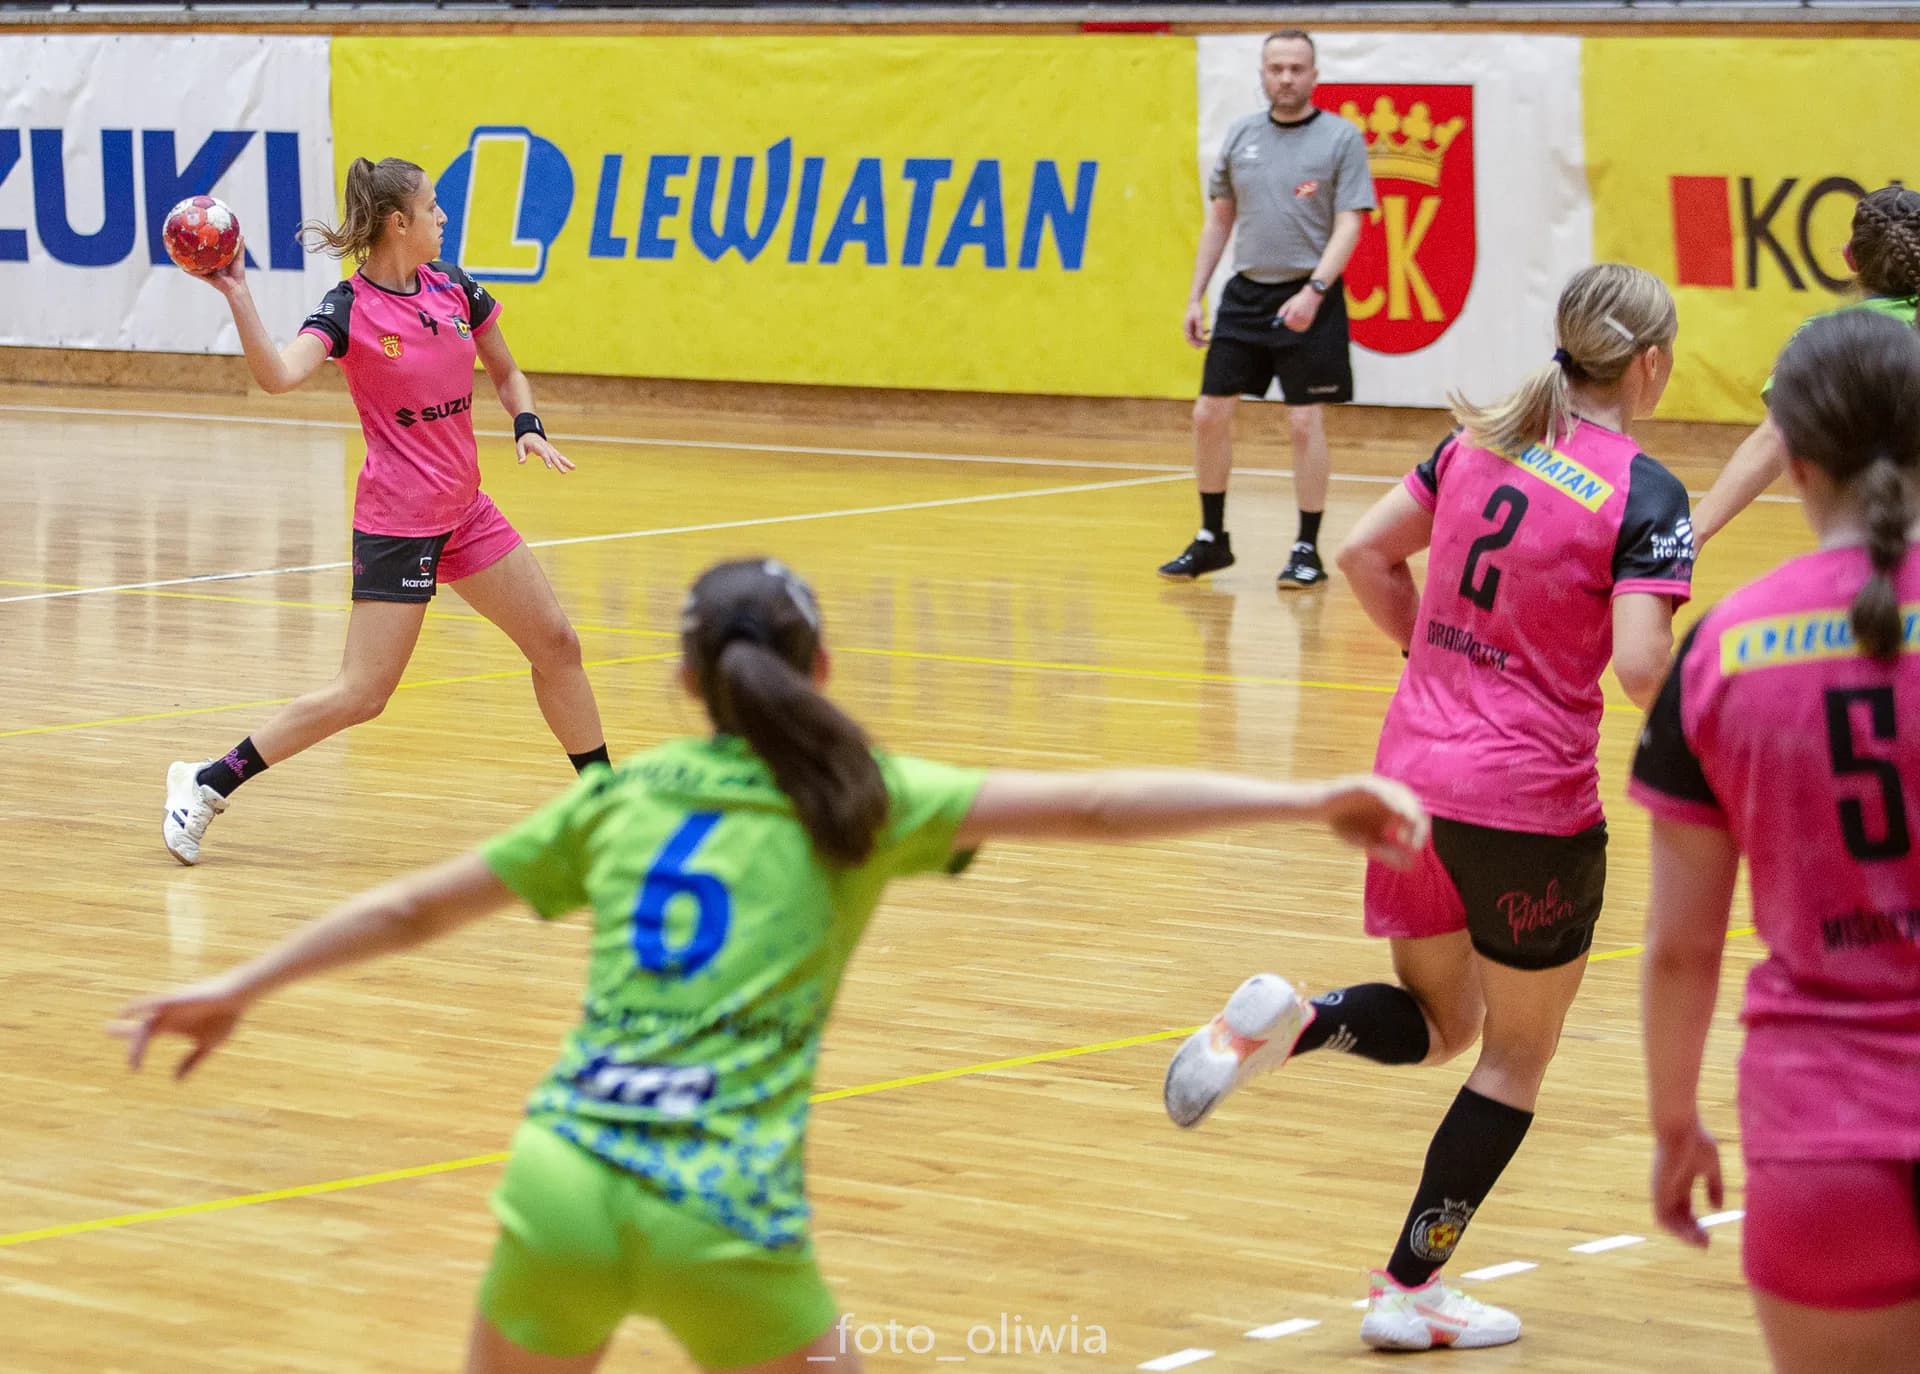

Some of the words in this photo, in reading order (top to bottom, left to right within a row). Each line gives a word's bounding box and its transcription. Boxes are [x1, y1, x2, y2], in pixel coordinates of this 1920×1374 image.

[588, 136, 1099, 270] LEWIATAN
[1738, 176, 1903, 297] KO
[418, 309, 438, 336] 4
[1520, 444, 1602, 500] WIATAN
[1459, 485, 1528, 612] 2
[1650, 532, 1677, 547] Sun
[1825, 686, 1910, 862] 5
[630, 810, 733, 982] 6
